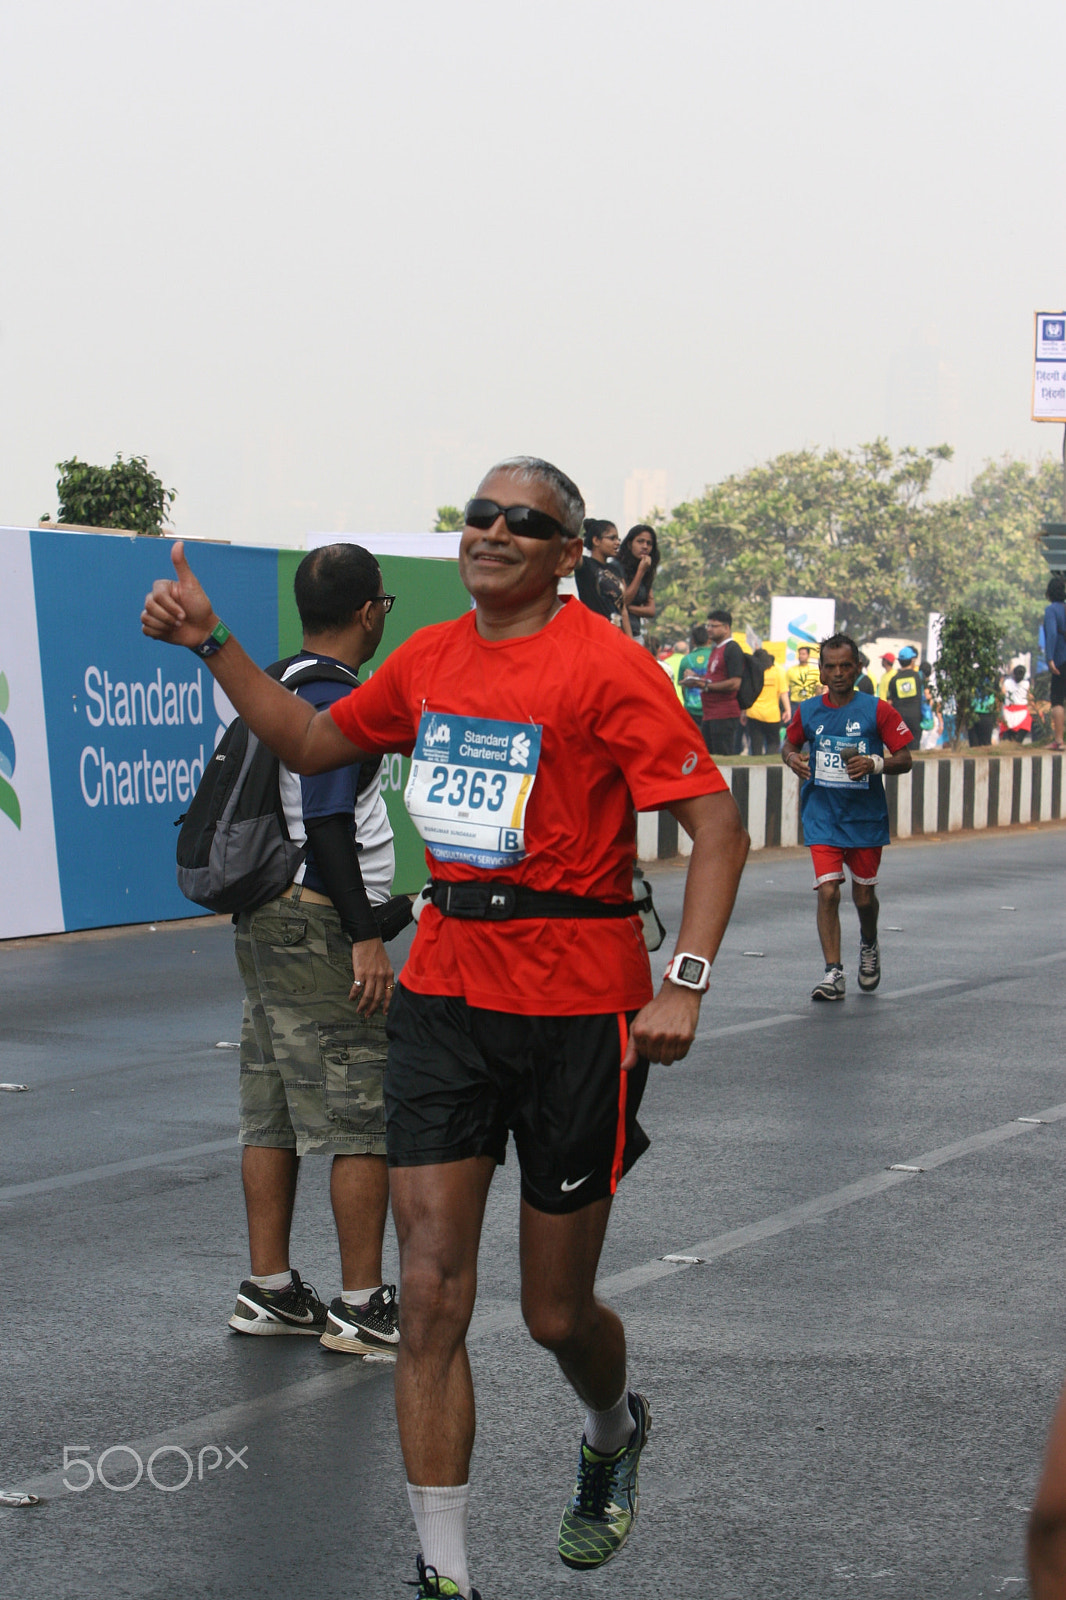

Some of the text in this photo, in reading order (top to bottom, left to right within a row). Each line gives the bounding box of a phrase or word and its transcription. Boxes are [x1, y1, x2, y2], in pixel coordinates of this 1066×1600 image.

[84, 665, 203, 727] Standard
[459, 744, 507, 762] Chartered
[464, 730, 509, 748] Standard
[79, 744, 205, 808] Chartered
[426, 765, 507, 812] 2363
[504, 831, 519, 850] B
